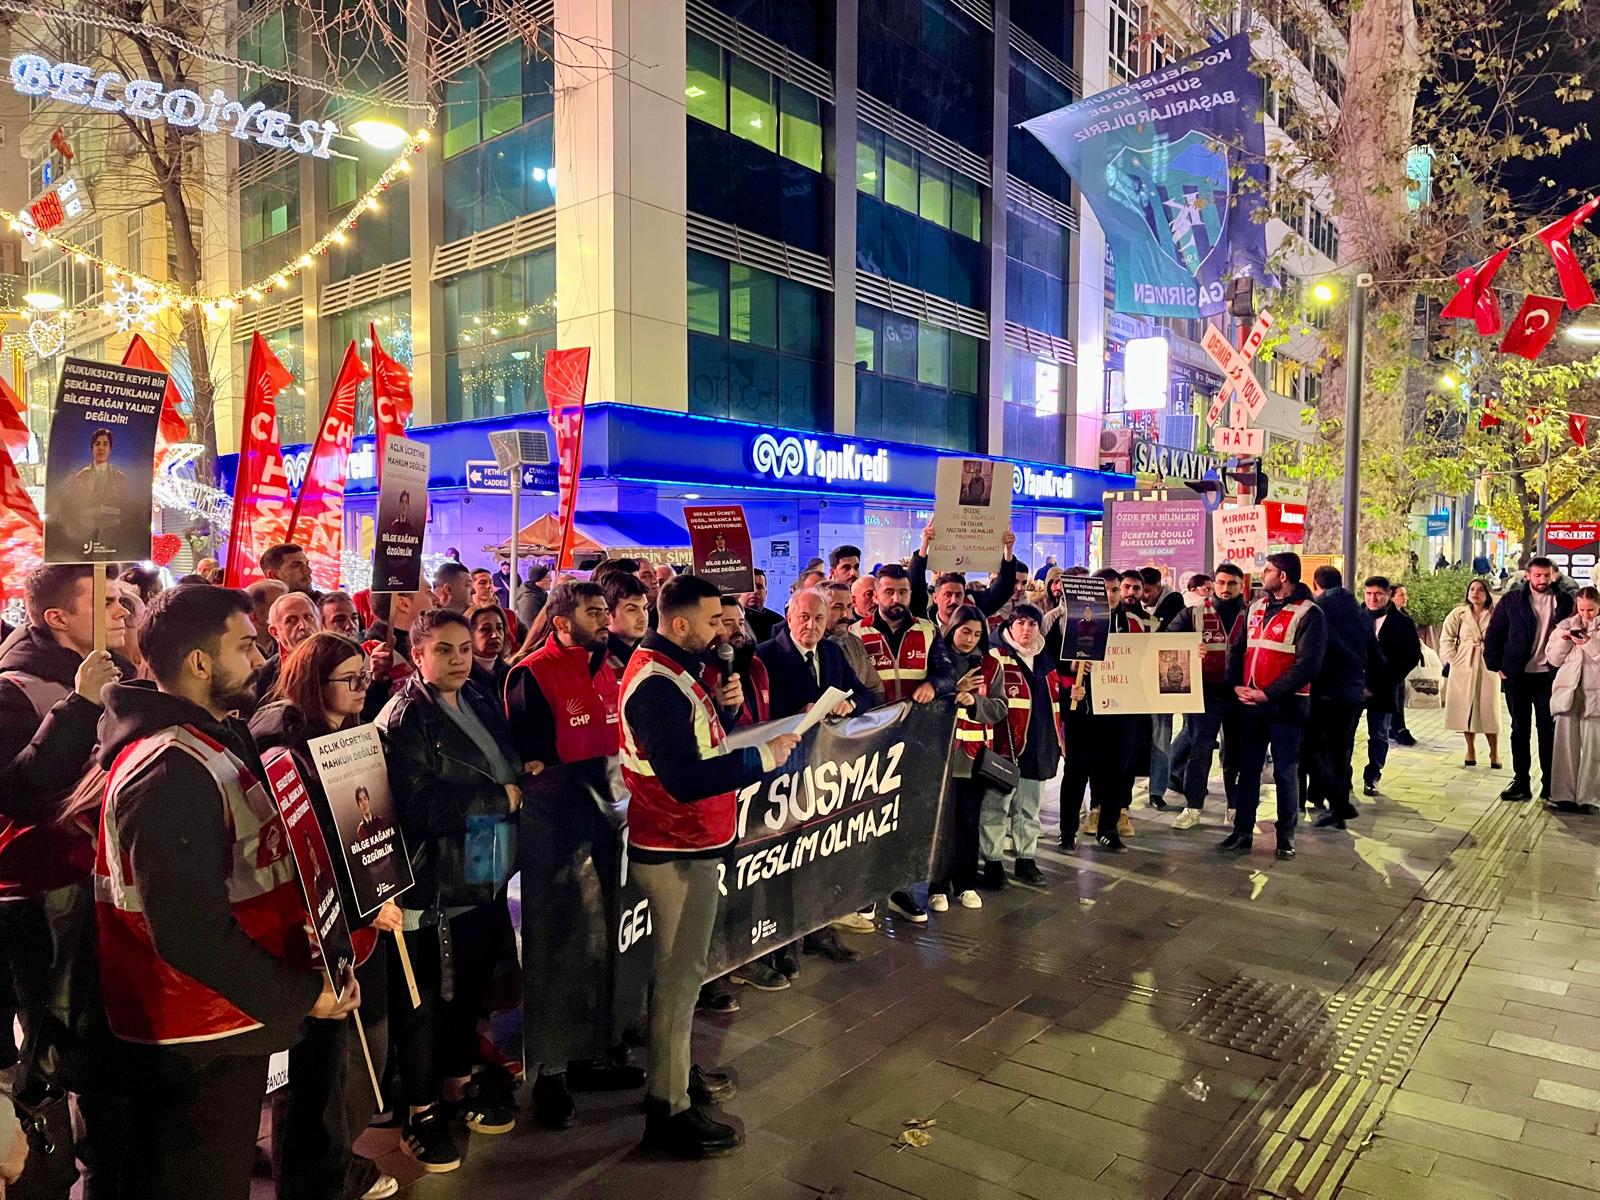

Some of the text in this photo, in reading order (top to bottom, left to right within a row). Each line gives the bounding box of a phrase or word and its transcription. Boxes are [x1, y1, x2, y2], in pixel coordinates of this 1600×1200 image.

[126, 373, 150, 386] KEYFİ
[151, 376, 165, 388] BİR
[64, 379, 160, 401] ŞEKİLDE TUTUKLANAN
[1241, 377, 1261, 409] YOLU
[63, 393, 155, 414] BİLGE KAĞAN YALNIZ
[85, 411, 129, 425] DEĞİLDİR!
[1223, 432, 1253, 447] HAT
[387, 456, 408, 468] MAHKUM
[1137, 441, 1168, 480] SAÇ
[484, 478, 509, 487] CADDESİ
[1116, 512, 1139, 521] ÖZDE
[1159, 513, 1200, 521] BİLİMLERİ
[1222, 511, 1259, 524] KIRMIZI
[1121, 530, 1159, 540] ÜCRETSİZ
[1225, 524, 1257, 537] IŞIKTA
[1120, 538, 1195, 547] BURSLULUK SINAVI
[667, 549, 692, 563] SİMİ
[1227, 546, 1255, 561] DUR
[569, 714, 591, 727] CHP
[318, 731, 372, 756] AÇLIK ÜCRETİNE
[321, 745, 379, 771] MAHKUM DEĞİLİZ!
[764, 742, 905, 831] SUSMAZ
[351, 841, 370, 854] BİLGE
[736, 831, 819, 890] TESLİM
[820, 794, 899, 858] OLMAZ!
[361, 843, 394, 867] ÖZGÜRLÜK
